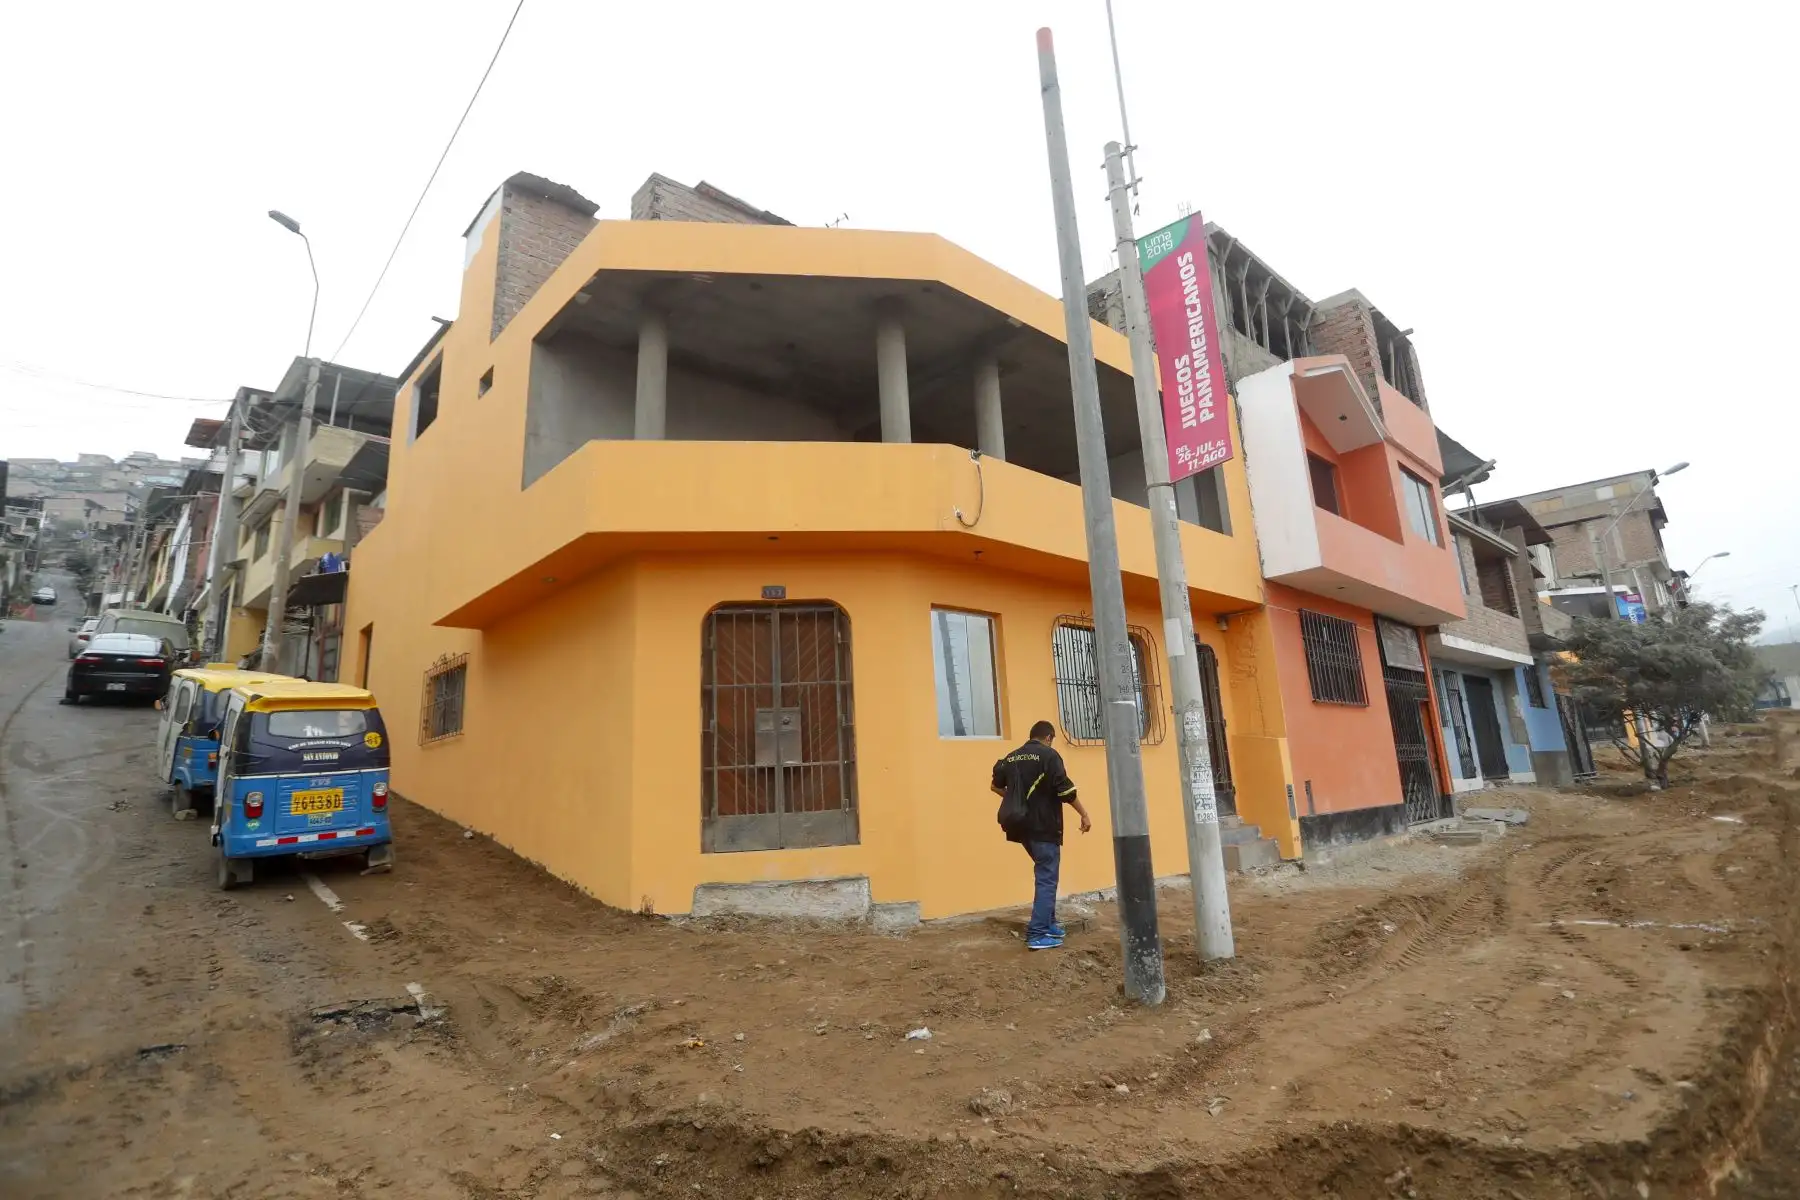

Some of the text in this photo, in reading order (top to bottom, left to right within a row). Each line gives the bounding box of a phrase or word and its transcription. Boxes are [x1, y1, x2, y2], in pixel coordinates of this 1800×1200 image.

[1146, 240, 1173, 259] 2019
[1177, 251, 1215, 424] PANAMERICANOS
[1174, 354, 1197, 429] JUEGOS
[1175, 444, 1189, 455] DEL
[1177, 439, 1226, 464] 26-JUL AL
[1187, 446, 1227, 471] 11-AGO
